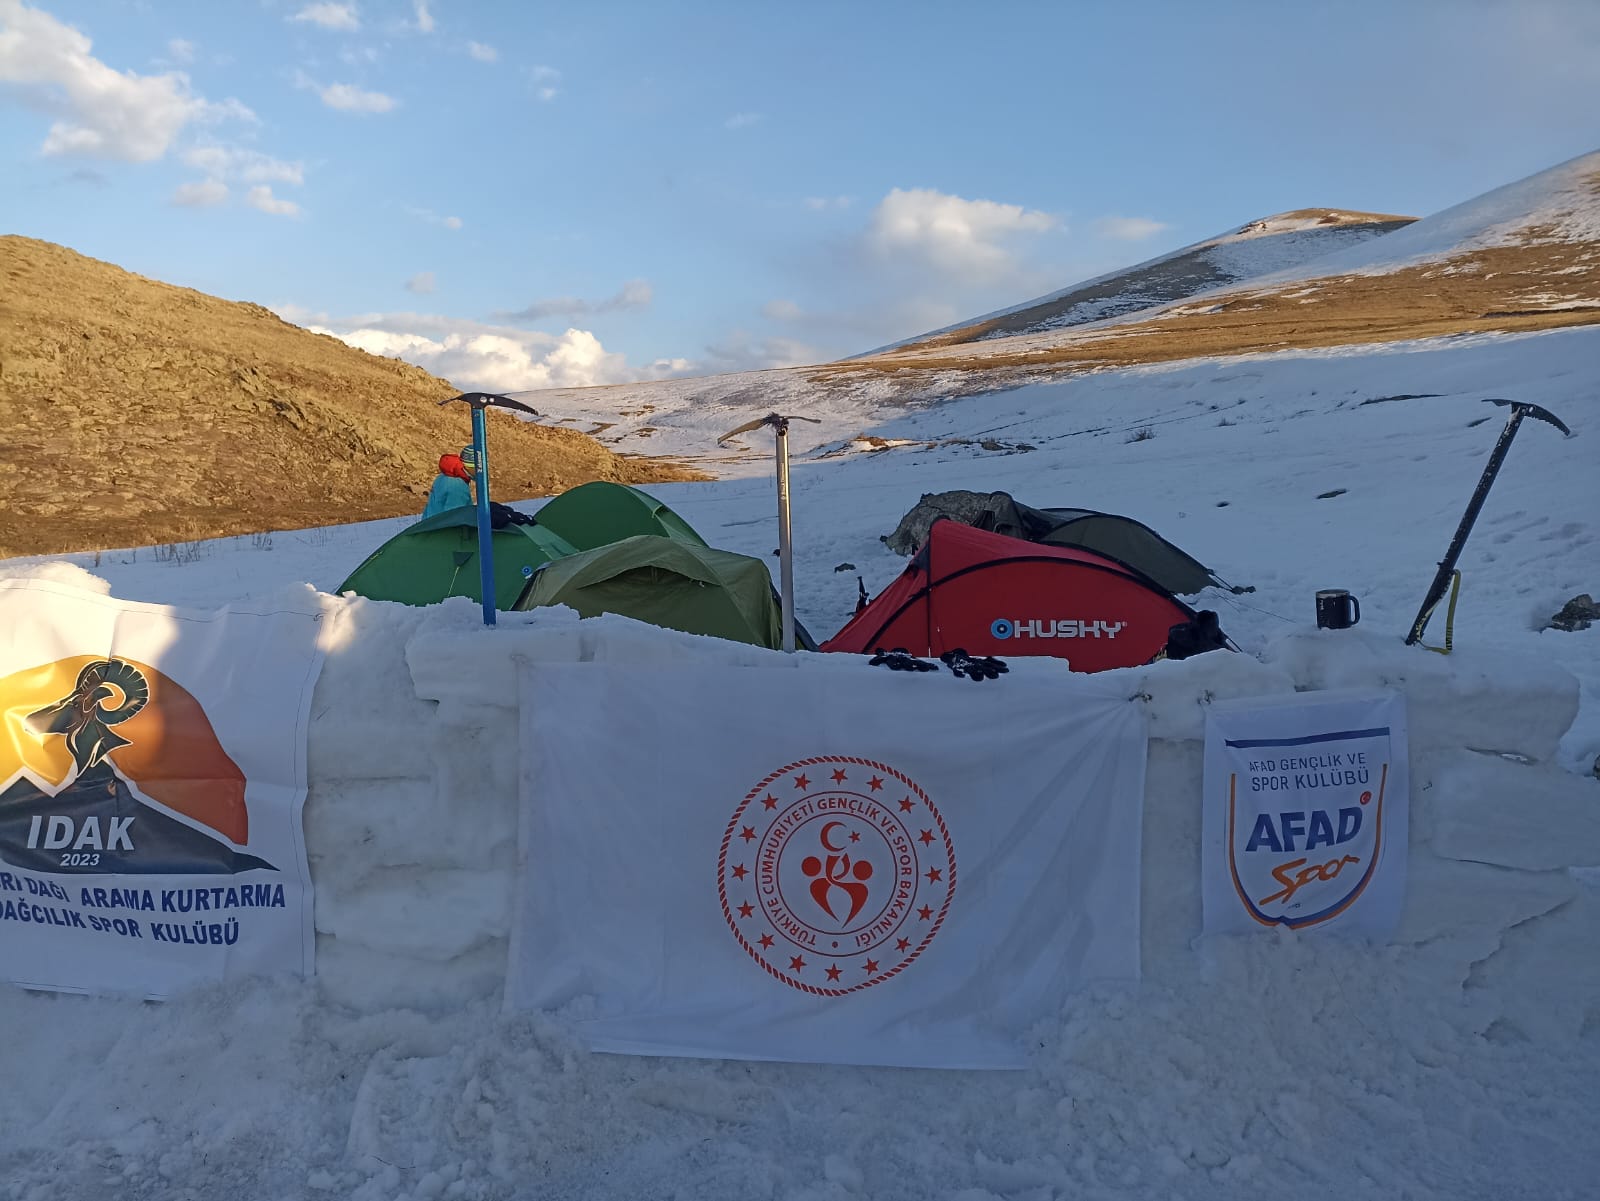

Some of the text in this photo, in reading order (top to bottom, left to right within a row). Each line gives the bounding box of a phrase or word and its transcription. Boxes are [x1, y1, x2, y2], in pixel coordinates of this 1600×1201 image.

[1014, 619, 1122, 638] HUSKY
[1249, 753, 1366, 772] AFAD GENÇLİK VE
[1252, 767, 1370, 791] SPOR KULÜBÜ
[27, 815, 135, 850] IDAK
[1245, 806, 1363, 853] AFAD
[60, 853, 100, 867] 2023
[763, 797, 912, 948] TÜRKİYE CUMHURİYETİ GENÇLİK VE SPOR BAKANLIĞI
[0, 872, 286, 913] RI DAĞI ARAMA KURTARMA
[1259, 854, 1360, 906] Spor
[89, 914, 143, 938] SPOR
[151, 917, 240, 946] KULÜBÜ
